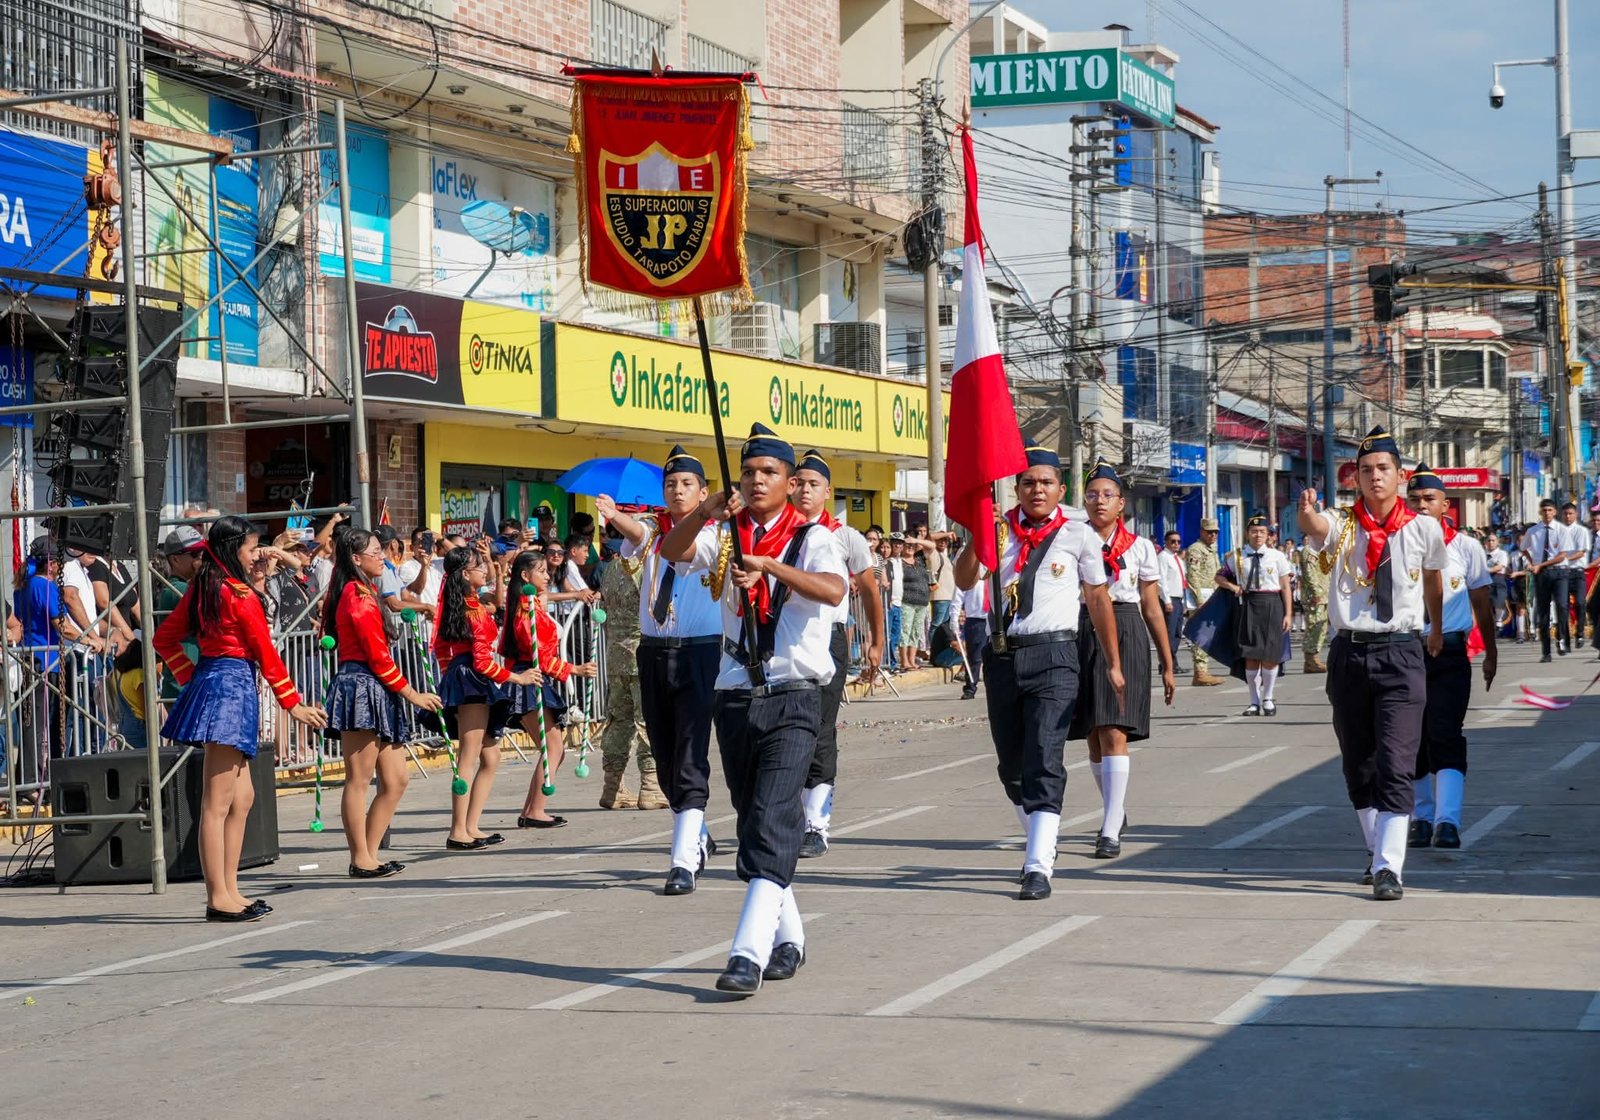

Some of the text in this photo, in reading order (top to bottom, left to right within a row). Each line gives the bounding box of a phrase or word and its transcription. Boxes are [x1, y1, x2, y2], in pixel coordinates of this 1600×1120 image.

[1121, 58, 1156, 110] FÁTIMA
[1156, 80, 1172, 117] INN
[618, 167, 703, 189] I E
[609, 197, 634, 247] ESTUDIO
[625, 197, 695, 212] SUPERACION
[686, 199, 709, 248] TRABAJO
[640, 214, 688, 250] JP
[633, 247, 692, 275] TARAPOTO
[367, 328, 437, 379] TE APUESTO
[785, 378, 862, 432] Inkafarma
